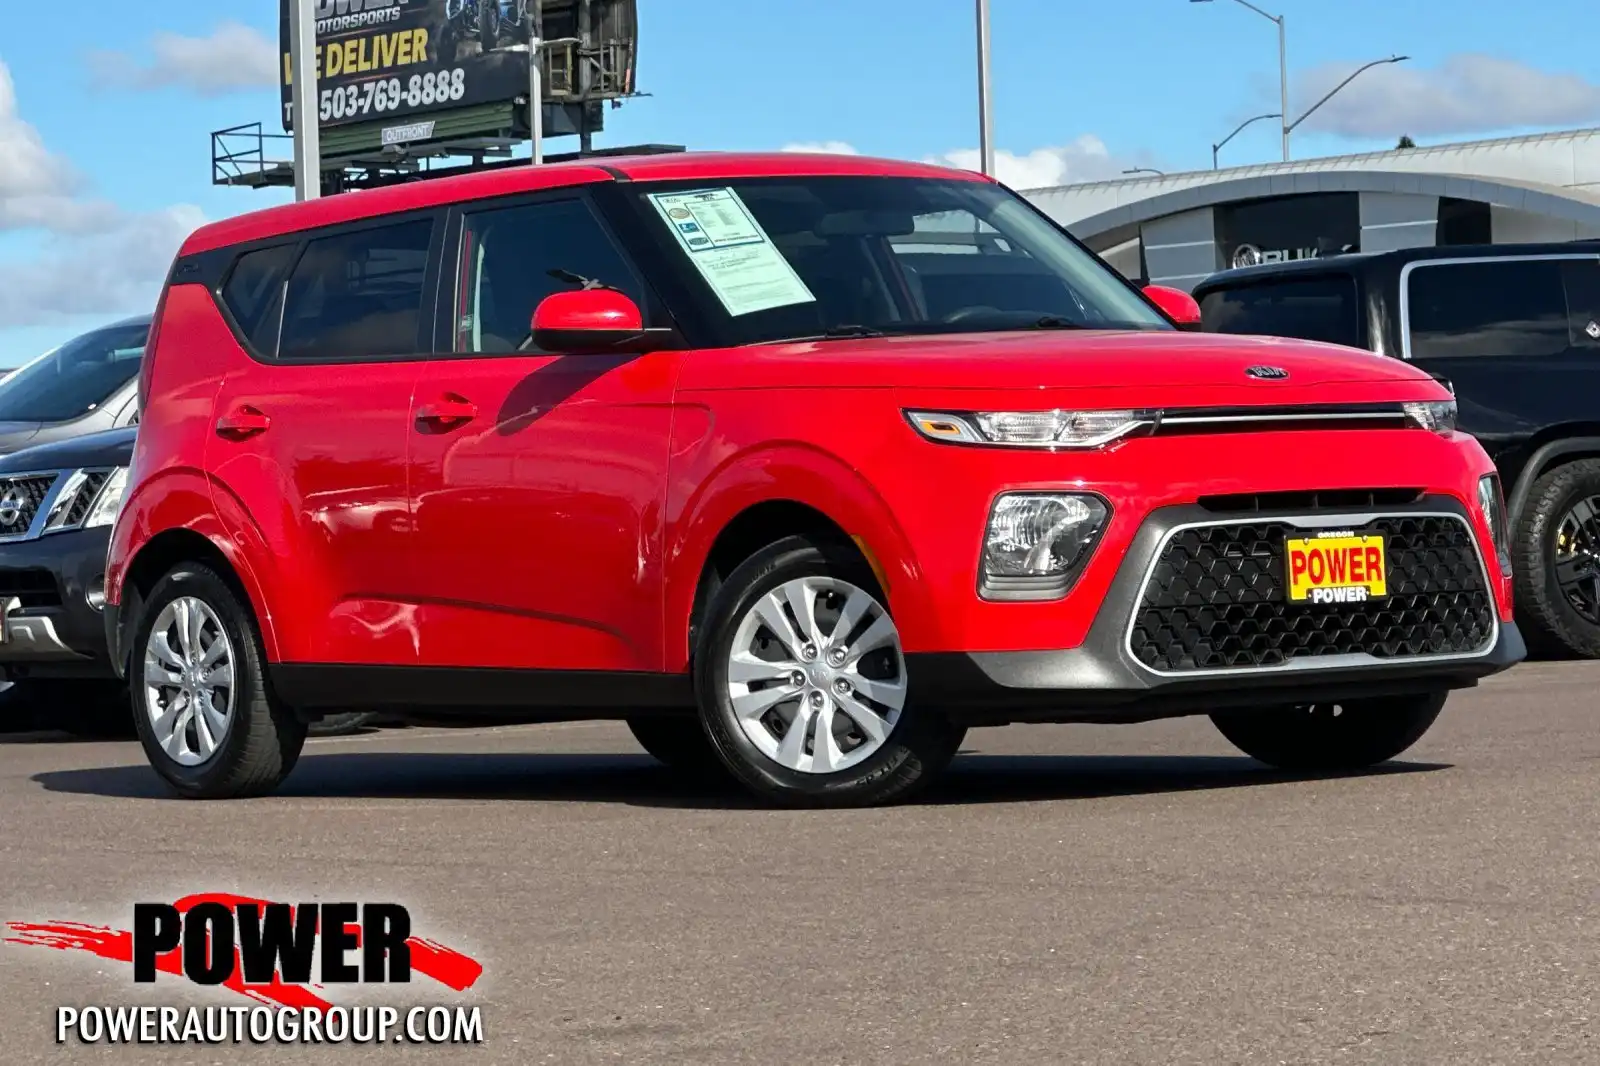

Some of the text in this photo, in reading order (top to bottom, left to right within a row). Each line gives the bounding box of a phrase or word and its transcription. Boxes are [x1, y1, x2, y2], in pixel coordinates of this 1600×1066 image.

[315, 6, 401, 34] OTORSPORTS
[326, 28, 429, 78] DELIVER
[319, 68, 465, 121] 503-769-8888
[386, 124, 429, 142] OUTFRONT
[1318, 531, 1354, 539] OREGON
[1291, 547, 1382, 585] POWER
[1313, 587, 1367, 604] POWER
